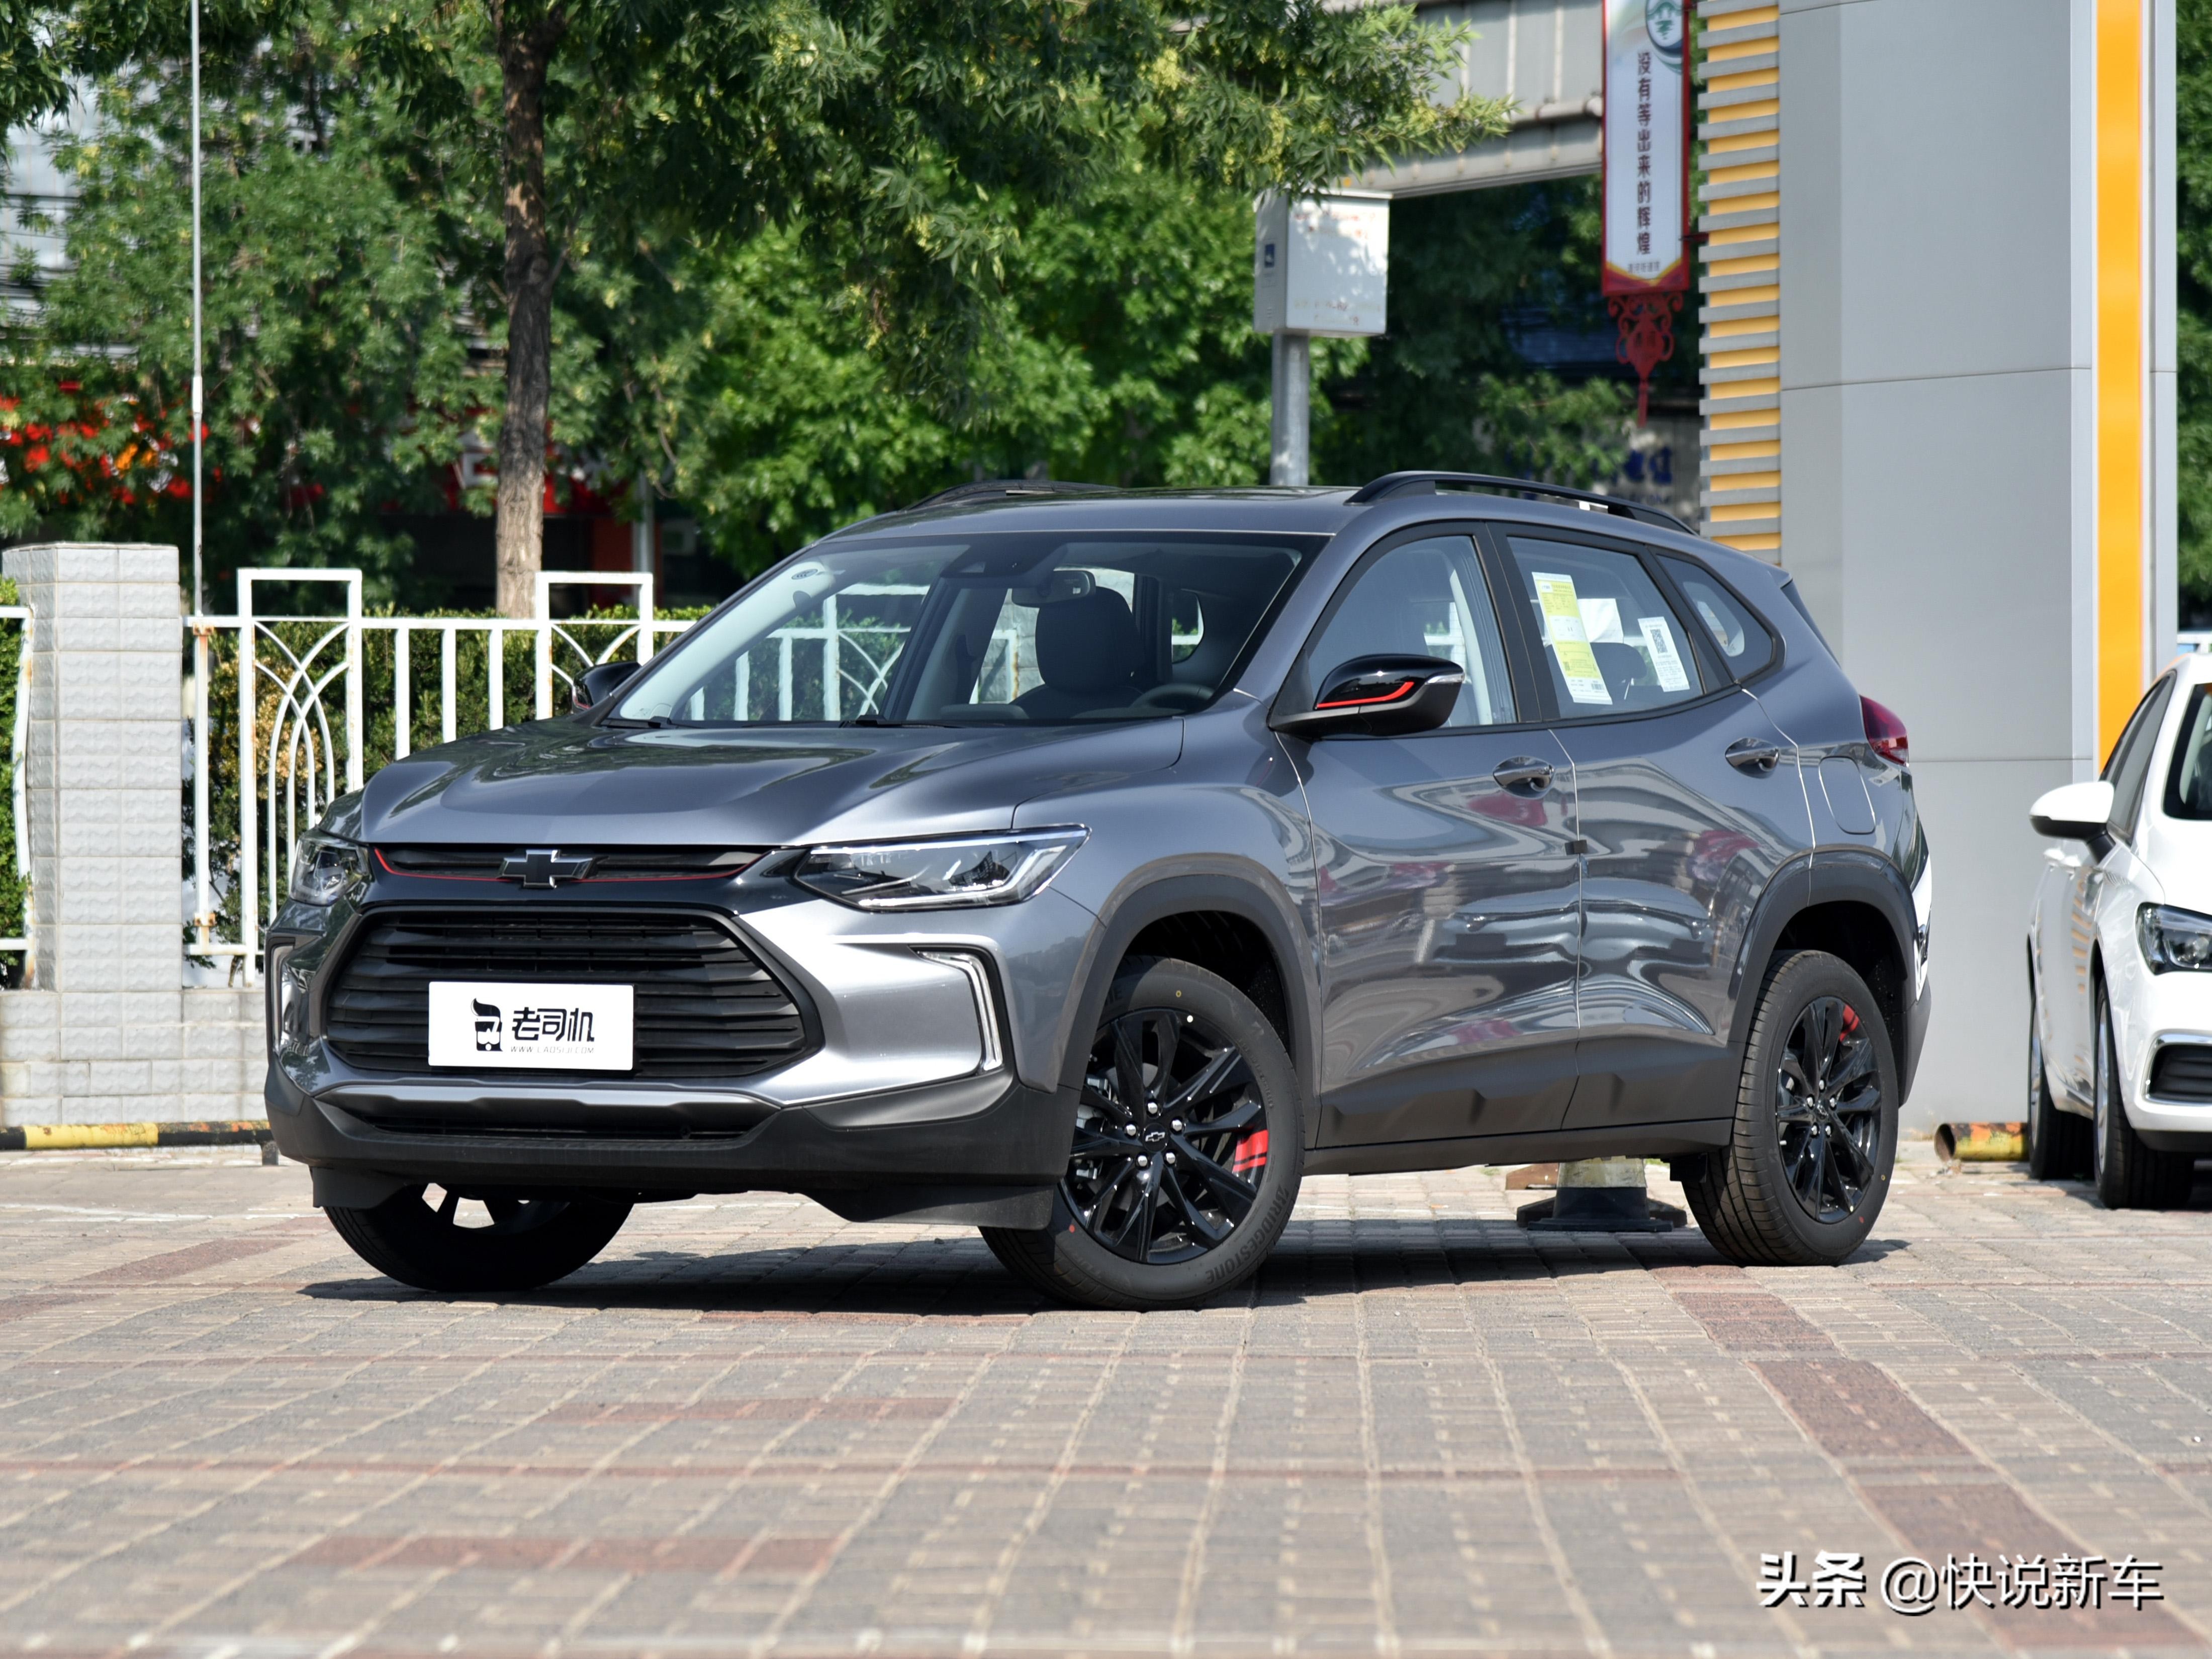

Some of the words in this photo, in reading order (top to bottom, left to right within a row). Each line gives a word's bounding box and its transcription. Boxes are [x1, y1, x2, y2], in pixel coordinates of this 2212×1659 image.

[1637, 51, 1651, 255] 没有等出来的辉煌
[512, 1007, 595, 1042] 老司机
[1206, 1184, 1289, 1284] BRIDGESTONE
